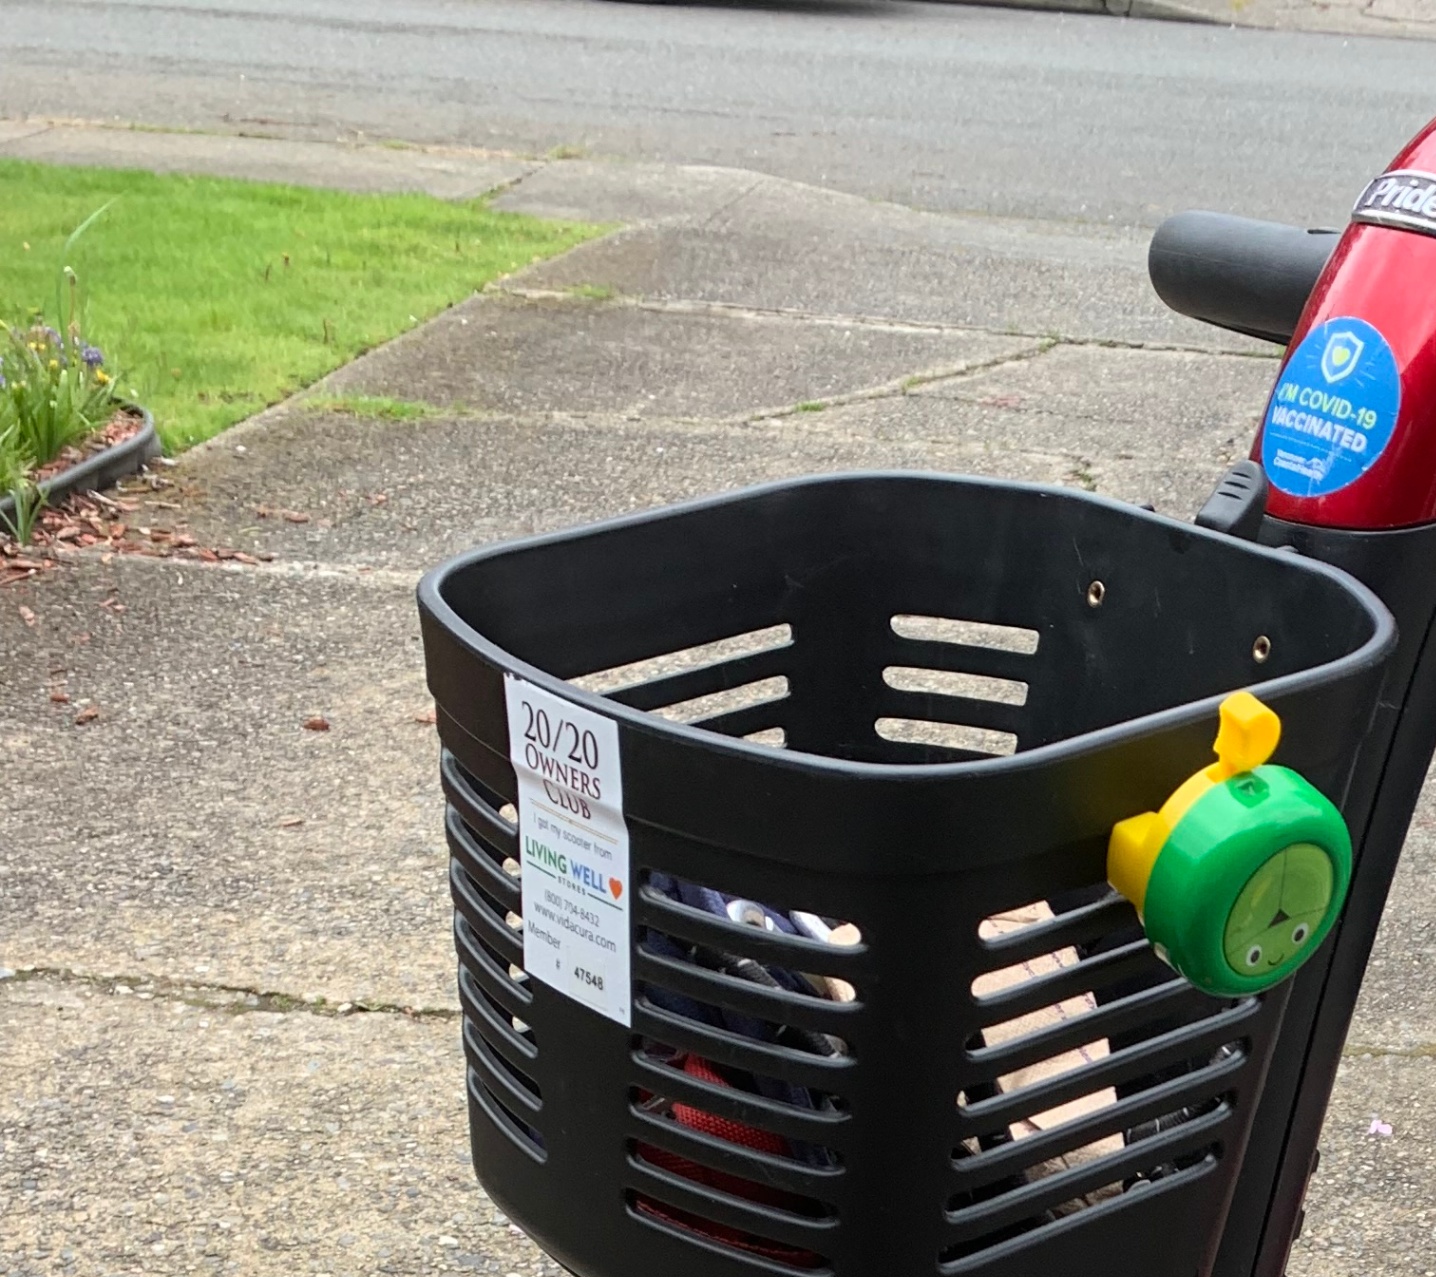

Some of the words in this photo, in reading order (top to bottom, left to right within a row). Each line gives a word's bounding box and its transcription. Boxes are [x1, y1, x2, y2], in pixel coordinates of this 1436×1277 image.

[1271, 405, 1367, 453] VACCINATED
[1277, 382, 1299, 404] I'M
[1299, 387, 1377, 430] COVID-19
[521, 700, 599, 770] 20/20
[525, 743, 601, 800] OWNERS
[543, 779, 592, 820] CLUB
[525, 835, 568, 875] LIVING
[570, 859, 607, 894] WELL
[550, 824, 561, 840] my
[562, 830, 592, 851] scooter
[593, 842, 613, 861] from
[557, 875, 586, 896] STORES
[528, 919, 561, 950] Member
[533, 902, 617, 953] www.vidacura.com
[573, 966, 604, 991] 47548
